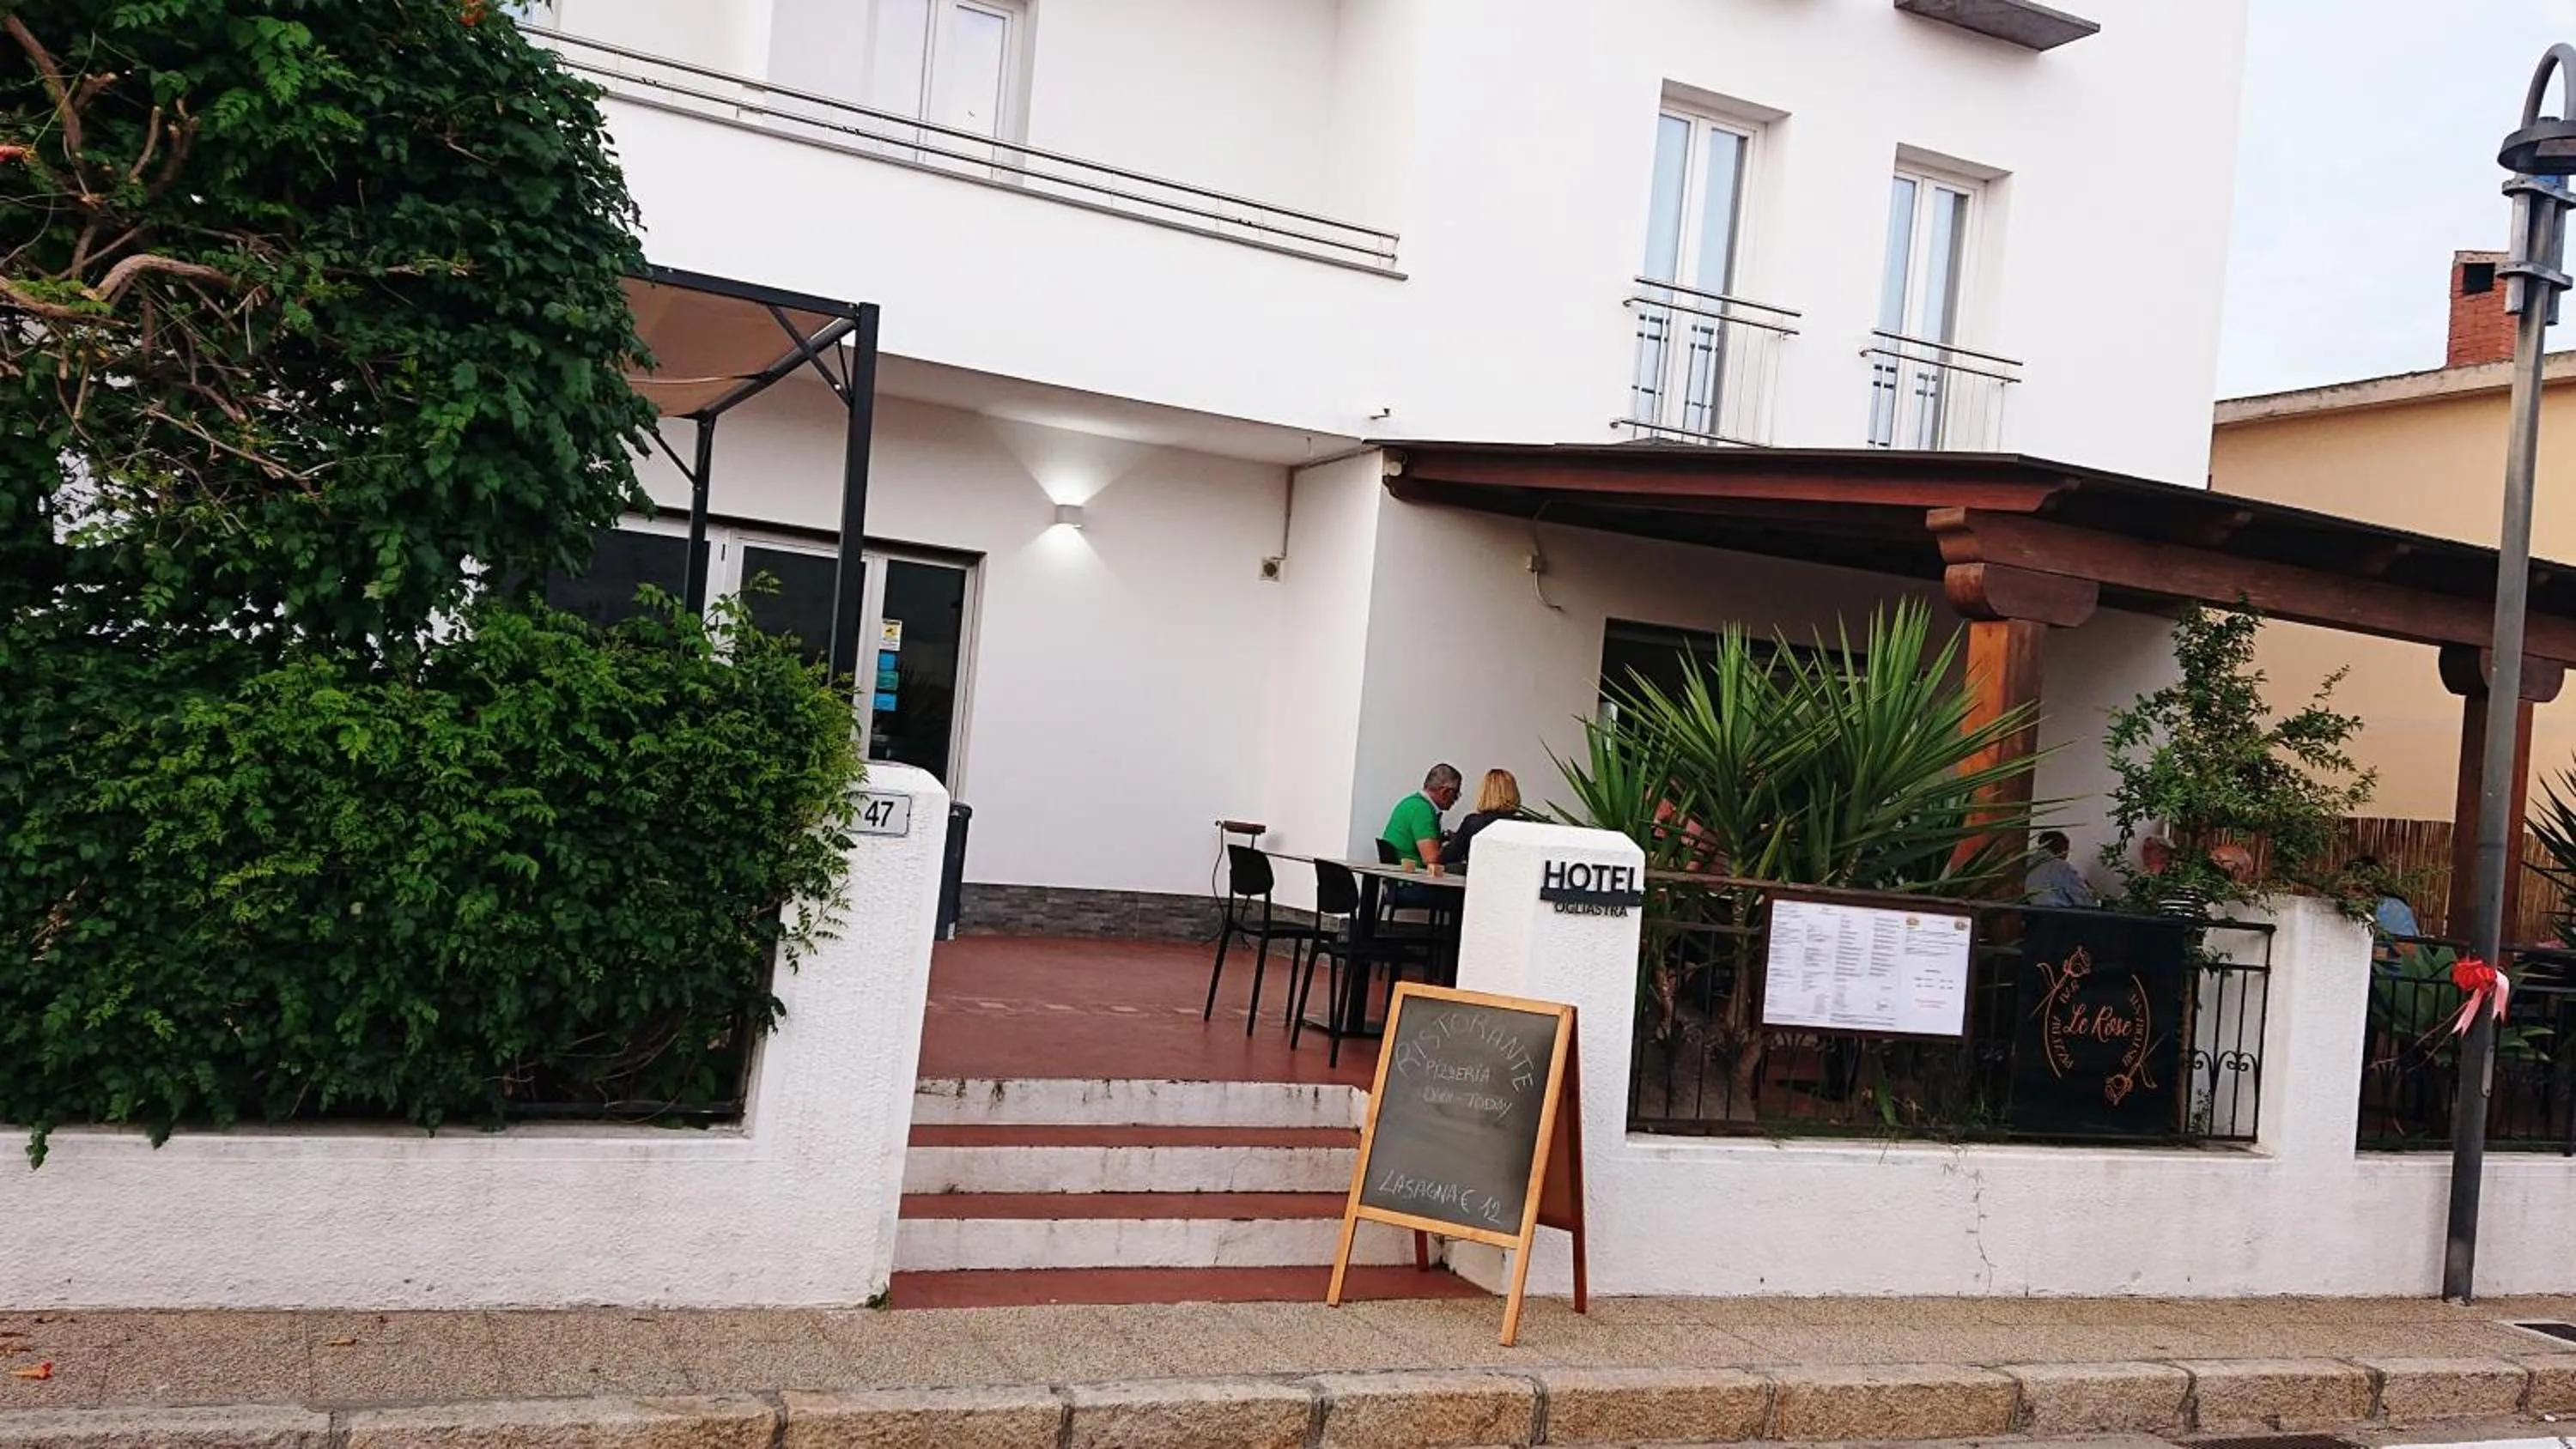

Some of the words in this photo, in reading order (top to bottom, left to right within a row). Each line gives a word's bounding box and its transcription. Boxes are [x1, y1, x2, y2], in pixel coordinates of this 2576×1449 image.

[864, 800, 895, 827] 47
[1544, 860, 1644, 892] HOTEL
[1554, 901, 1628, 917] OGLIASTRA
[1395, 1012, 1534, 1092] RISTORANTE
[1465, 1091, 1512, 1119] TODAY
